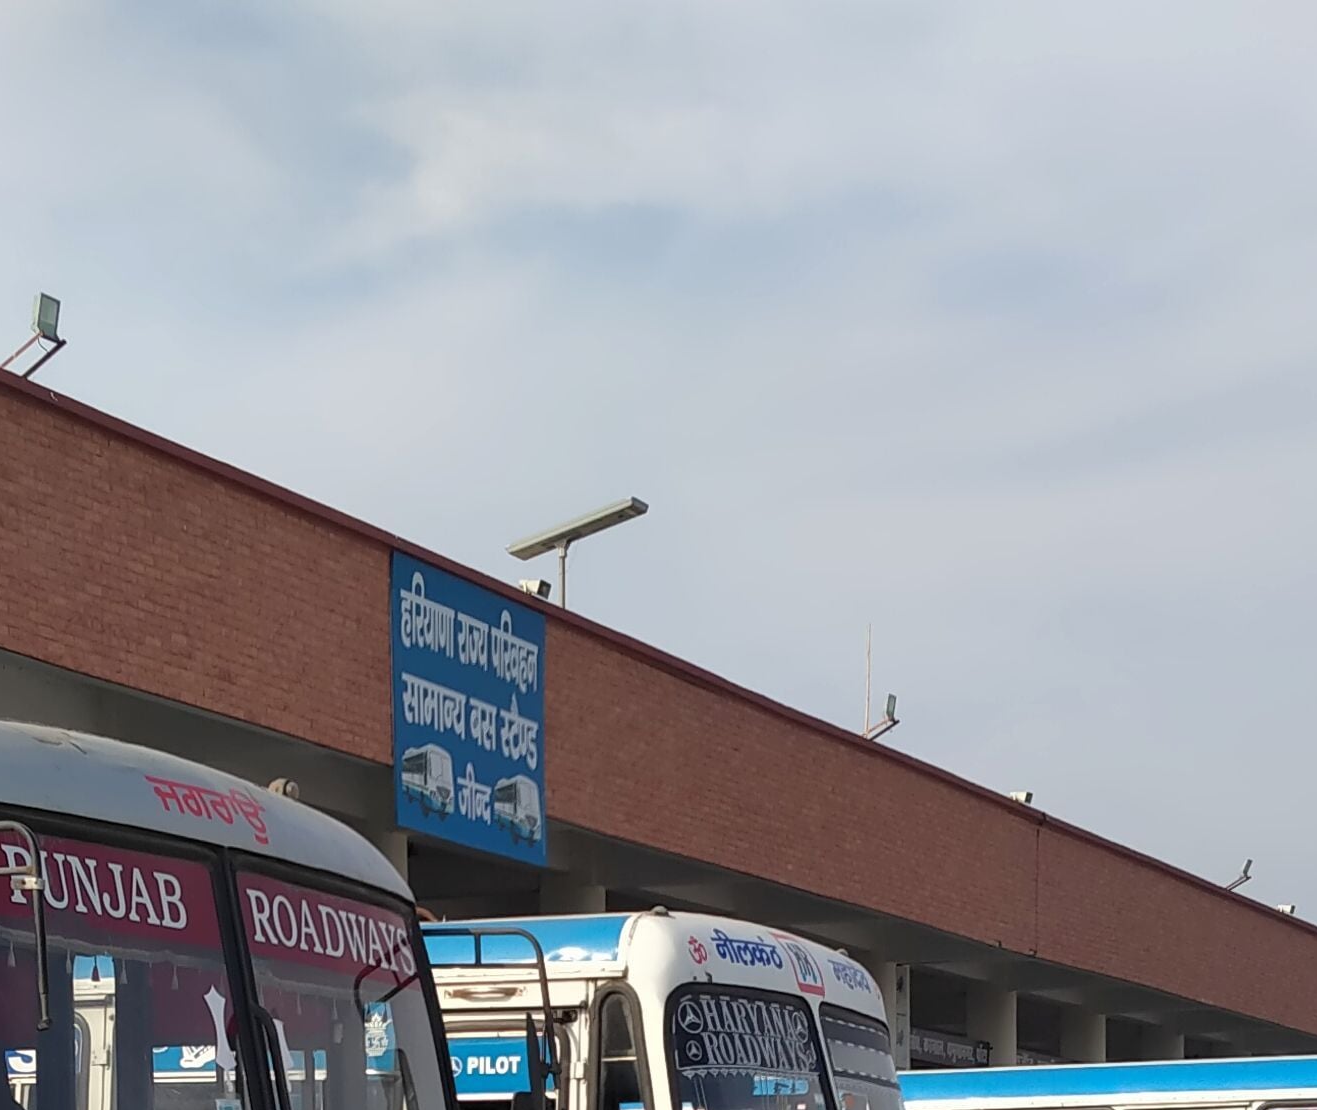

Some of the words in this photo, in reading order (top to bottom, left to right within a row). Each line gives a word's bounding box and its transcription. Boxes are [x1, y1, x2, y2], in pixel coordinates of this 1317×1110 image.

[400, 571, 455, 659] हरियाणा
[457, 610, 489, 671] राज्य
[490, 608, 539, 693] परिवहन
[401, 672, 466, 740] सामान्य
[469, 697, 497, 752] बस
[457, 762, 493, 826] जीन्द
[0, 842, 189, 930] PUNJAB
[246, 888, 417, 977] ROADWAYS
[700, 998, 798, 1041] HARYANA
[467, 1055, 522, 1075] PILOT
[700, 1031, 812, 1074] ROADWAYS
